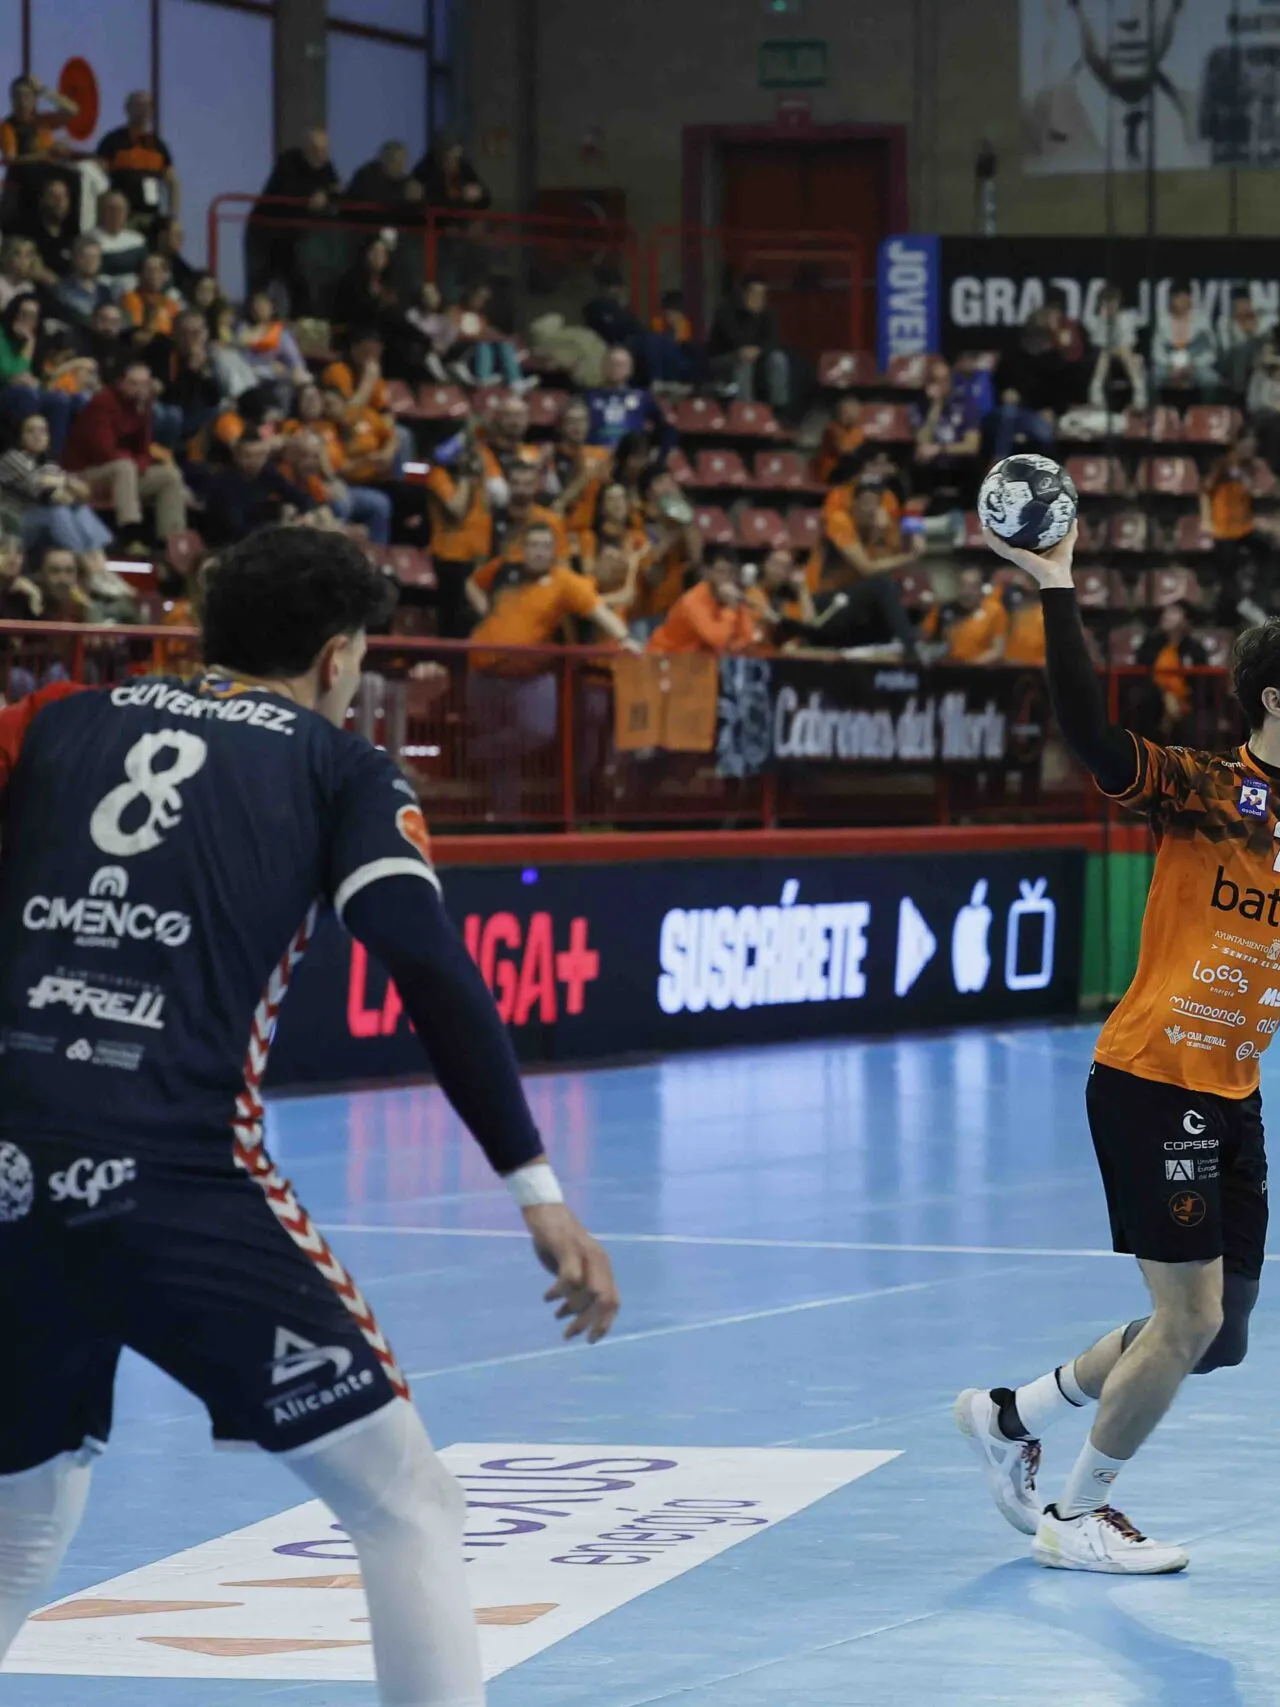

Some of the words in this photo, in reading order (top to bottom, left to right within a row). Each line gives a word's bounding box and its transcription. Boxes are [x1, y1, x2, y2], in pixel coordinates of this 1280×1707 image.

[90, 728, 208, 857] 8
[657, 878, 871, 1015] SUSCRÍBETE
[1169, 994, 1247, 1026] mimoondo
[1203, 1033, 1227, 1048] RURAL
[1163, 1139, 1220, 1151] COPSESA
[273, 1368, 374, 1425] Alicante
[550, 1498, 770, 1566] energía
